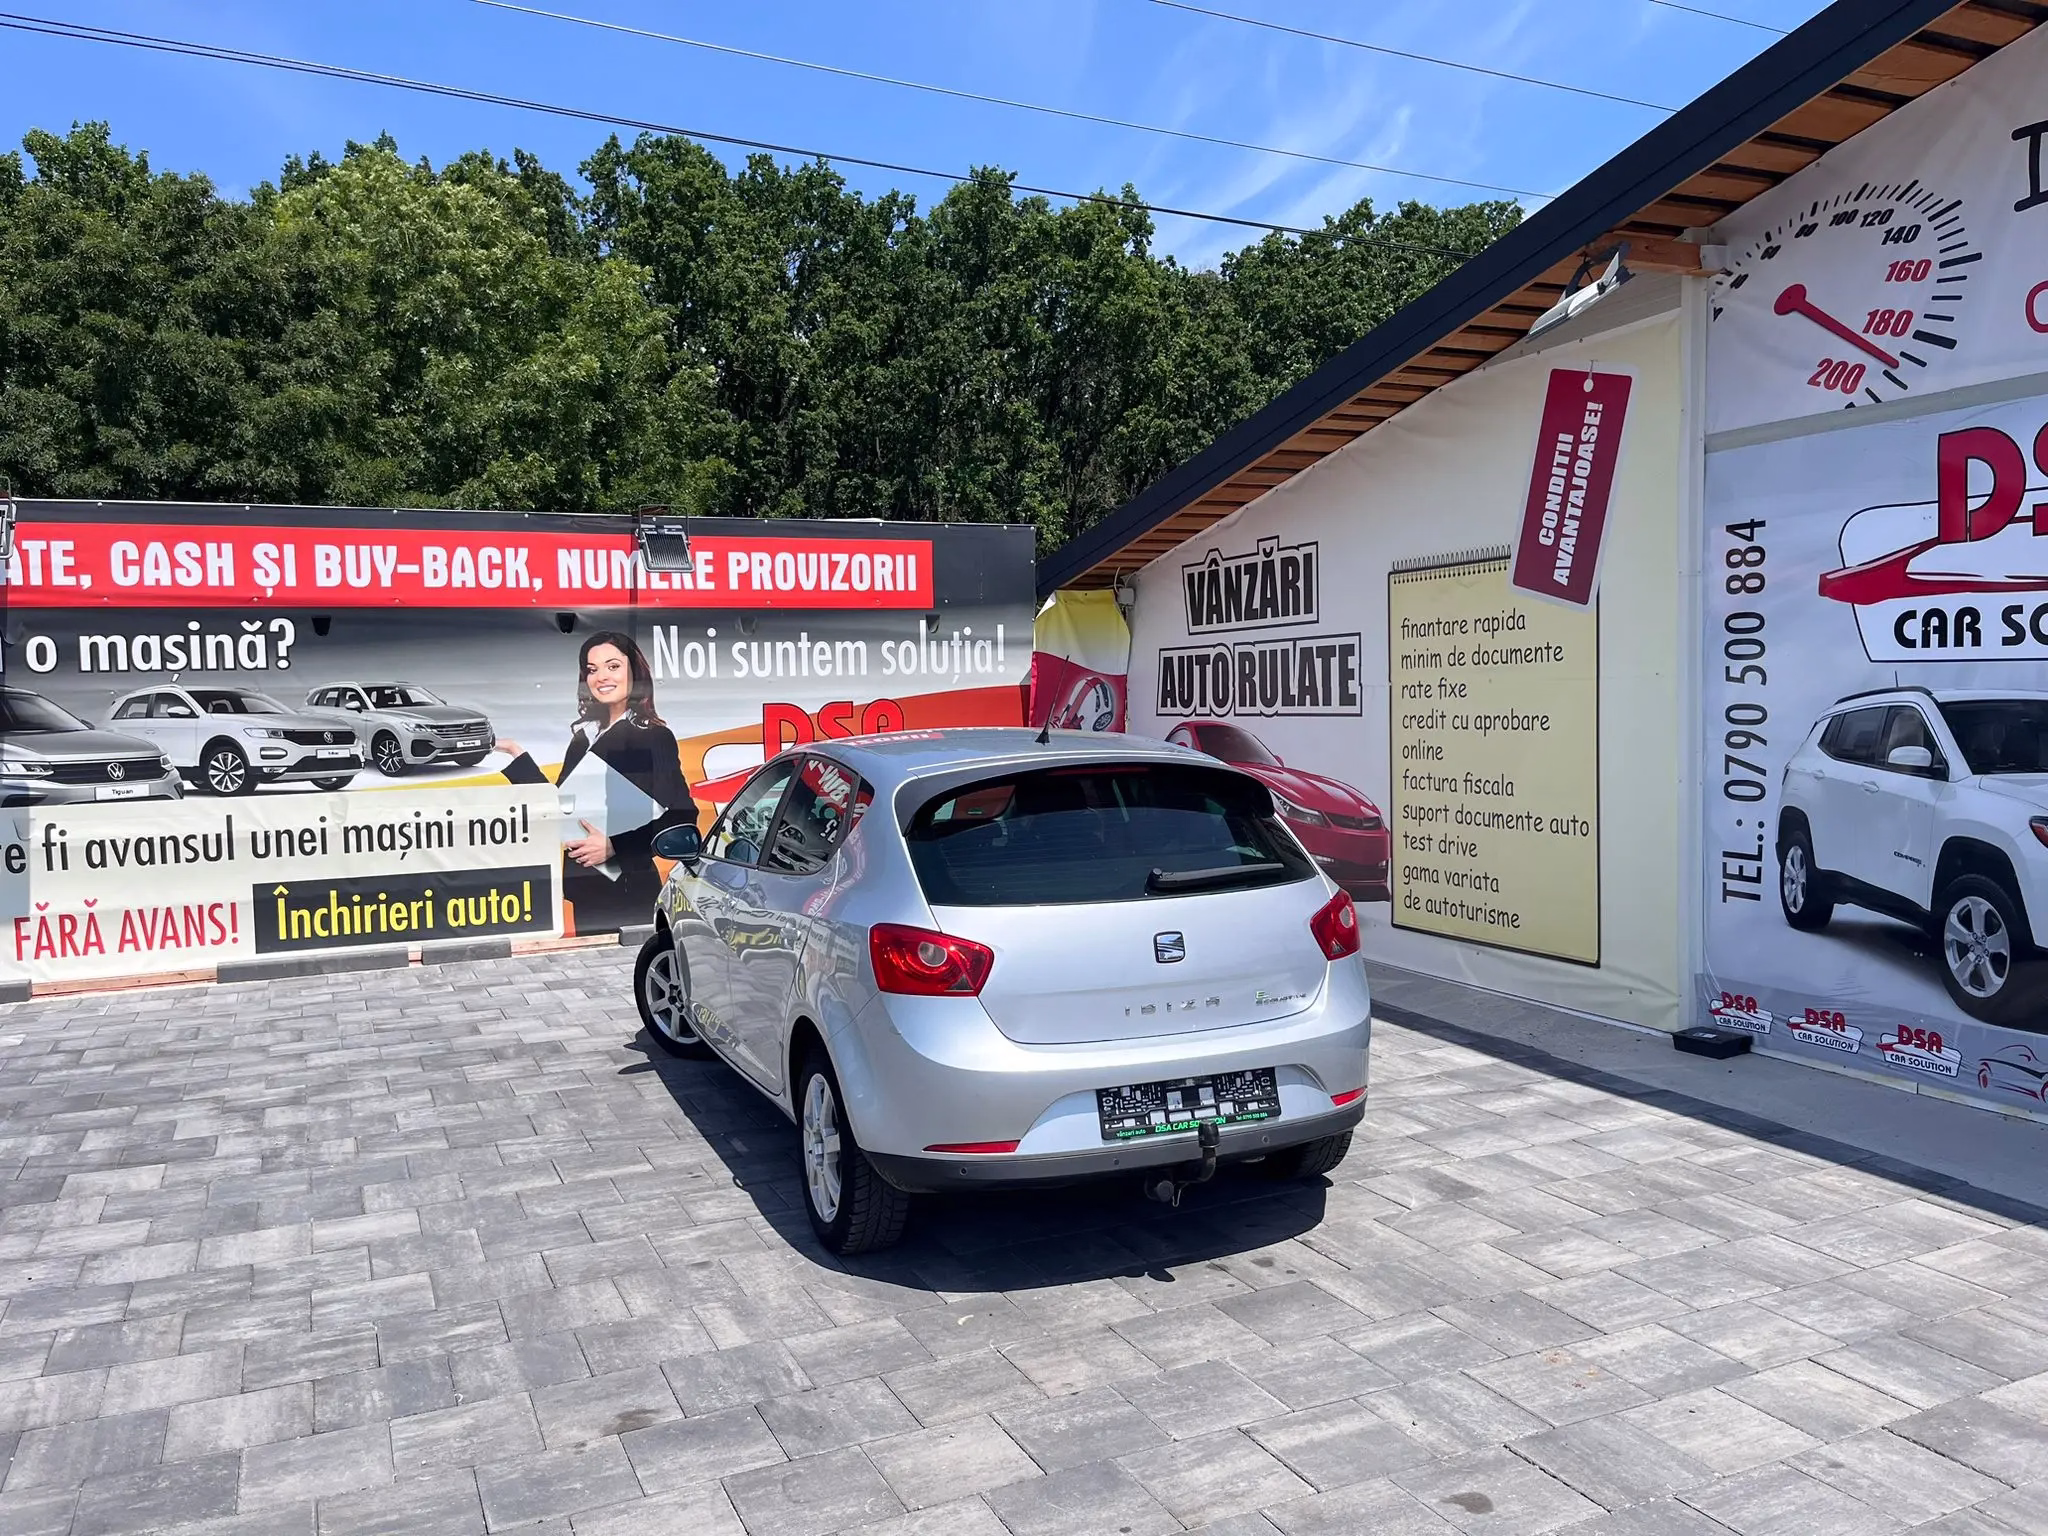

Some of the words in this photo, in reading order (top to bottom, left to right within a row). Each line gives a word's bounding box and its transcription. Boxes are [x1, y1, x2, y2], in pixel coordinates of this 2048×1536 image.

[1829, 209, 1859, 227] 100
[1860, 208, 1894, 228] 120
[1881, 224, 1921, 246] 140
[1885, 259, 1932, 282] 160
[1862, 309, 1913, 337] 180
[1807, 358, 1866, 394] 200
[1538, 432, 1575, 547] CONDITII
[1553, 401, 1604, 587] AVANTAJOASE!
[1937, 422, 2048, 543] D
[110, 541, 234, 586] CASH
[728, 551, 917, 592] PROVIZORII
[1725, 518, 1766, 595] 884
[1187, 547, 1314, 627] VÂNZĂRI
[1401, 617, 1469, 640] finantare
[1473, 608, 1526, 639] rapida
[1894, 607, 1982, 649] CAR
[25, 635, 58, 673] o
[78, 617, 297, 682] mașină?
[653, 625, 717, 679] Noi
[733, 631, 867, 677] suntem
[1401, 648, 1442, 669] minim
[1447, 645, 1467, 666] de
[1471, 641, 1564, 666] documente
[1724, 611, 1767, 686] 500
[1160, 651, 1230, 709] AUTO
[1238, 643, 1357, 708] RULATE
[1401, 680, 1433, 699] rate
[1438, 677, 1468, 700] fixe
[1402, 708, 1447, 730] credit
[1451, 714, 1469, 730] cu
[1474, 708, 1551, 737] aprobare
[1402, 738, 1444, 760] online
[1723, 702, 1768, 803] 0790
[1402, 768, 1458, 793] factura
[1463, 772, 1514, 797] fiscala
[1402, 803, 1450, 827] suport
[1455, 803, 1544, 832] documente
[1549, 814, 1590, 837] auto
[42, 822, 69, 872] fi
[85, 815, 236, 870] avansul
[251, 815, 329, 859] unei
[468, 804, 531, 846] noi!
[1402, 831, 1433, 852] test
[1438, 833, 1478, 857] drive
[1403, 864, 1440, 885] gama
[1444, 869, 1500, 893] variata
[272, 884, 435, 941] Închirieri
[446, 881, 534, 928] auto!
[1404, 889, 1422, 911] de
[1425, 897, 1521, 929] autoturisme
[14, 898, 106, 961] FĂRĂ
[117, 901, 240, 954] AVANS!
[1124, 996, 1221, 1017] IBIZA
[1721, 991, 1758, 1014] DSA
[1804, 1008, 1846, 1033] DSA
[1797, 1032, 1813, 1043] CAR
[1814, 1035, 1853, 1051] SOLUTION
[1897, 1024, 1942, 1054] DSA
[1890, 1053, 1907, 1065] CAR
[1908, 1057, 1952, 1075] SOLUTION
[1155, 1124, 1172, 1133] DSA
[1172, 1122, 1189, 1131] CAR
